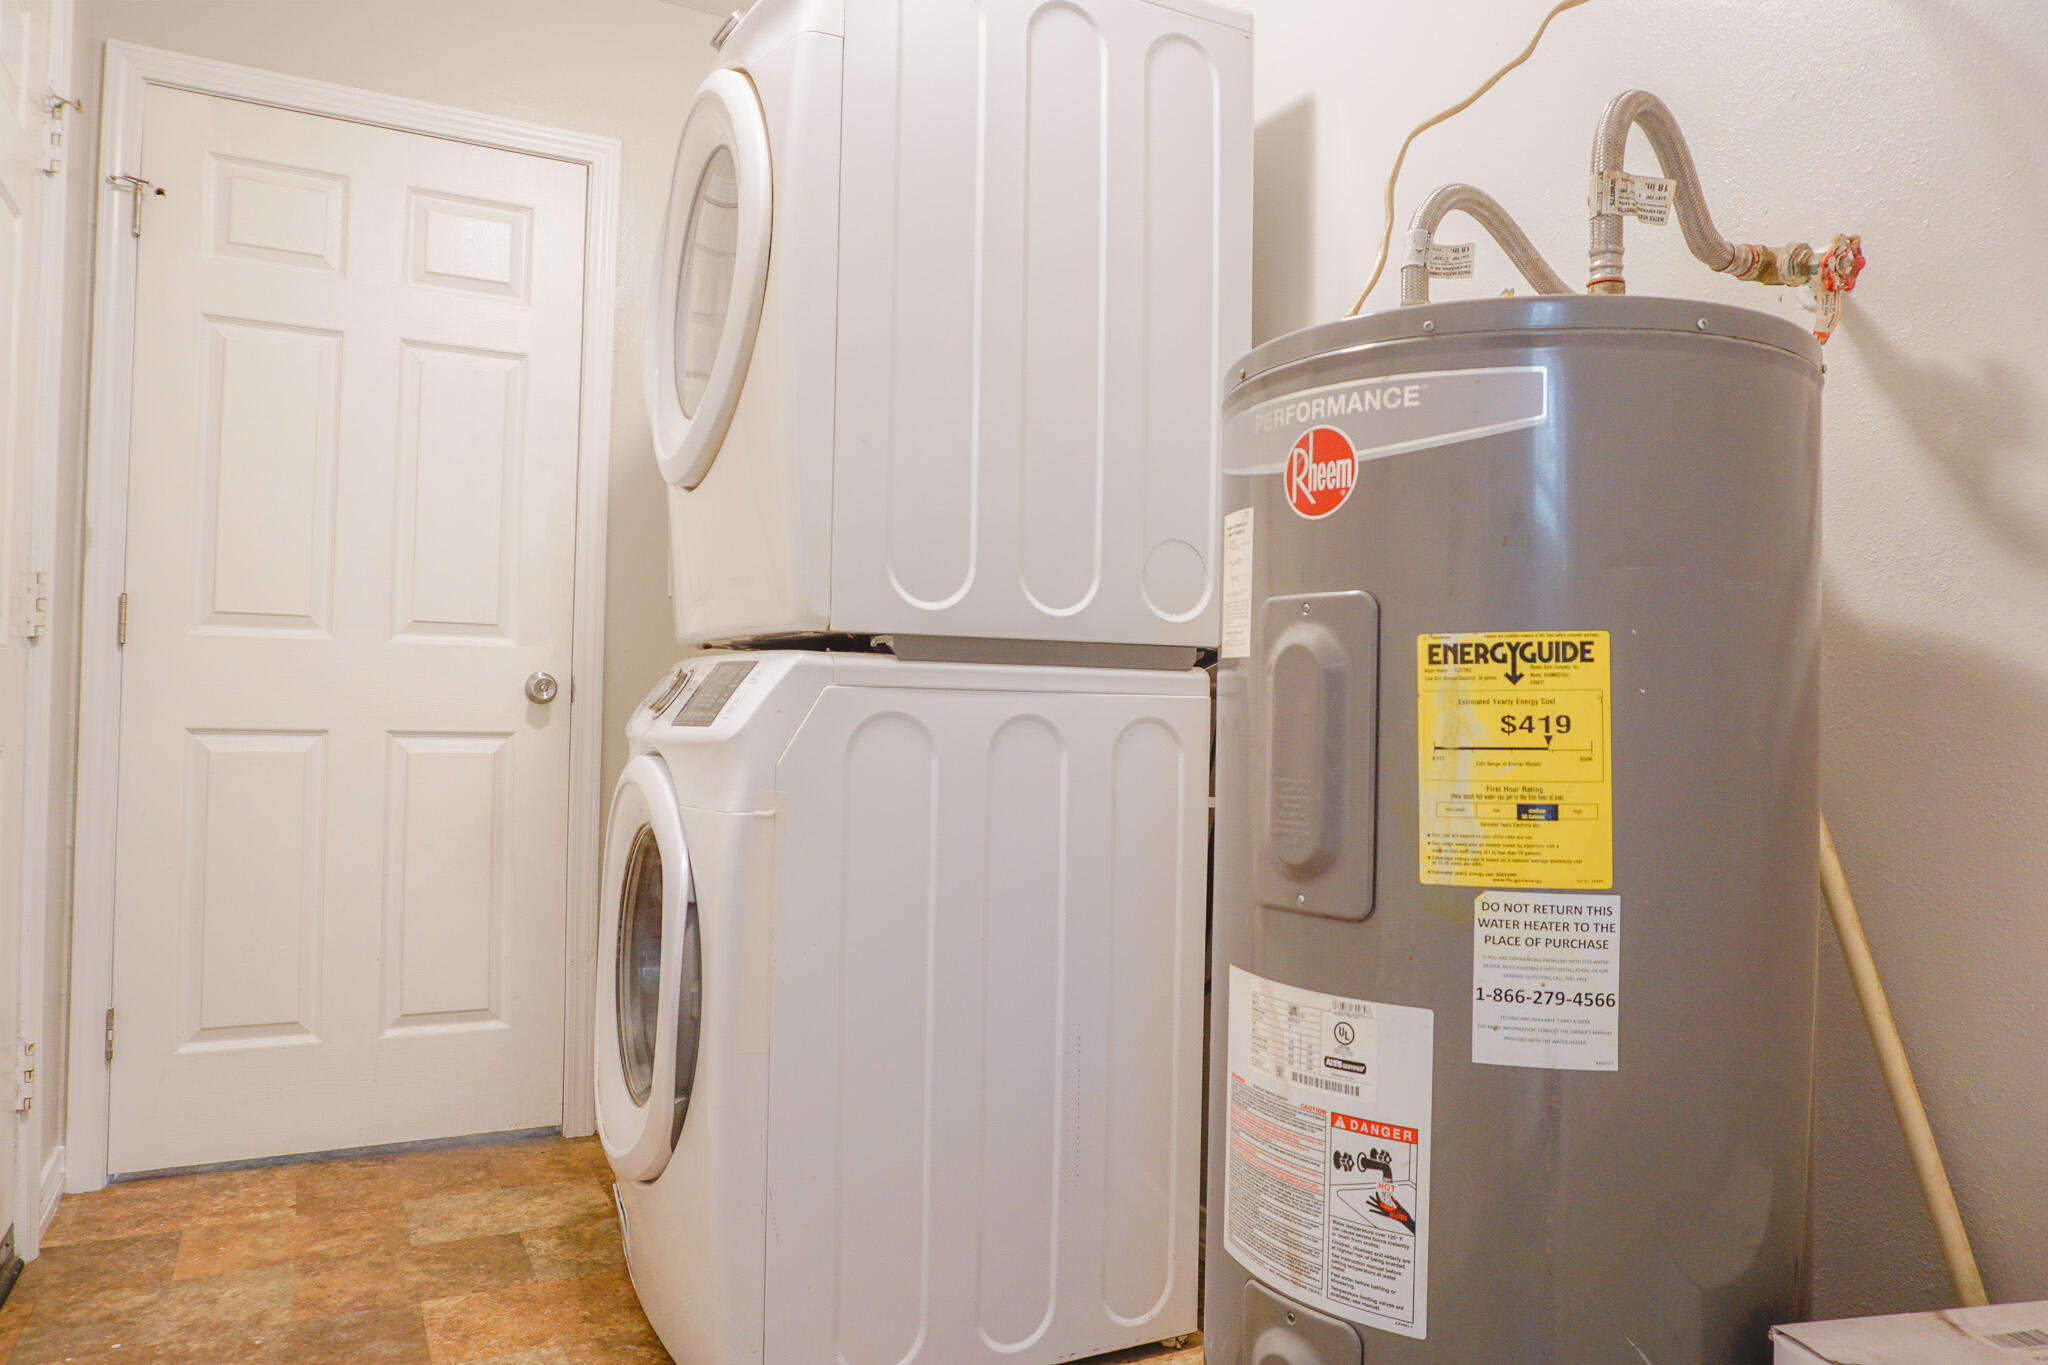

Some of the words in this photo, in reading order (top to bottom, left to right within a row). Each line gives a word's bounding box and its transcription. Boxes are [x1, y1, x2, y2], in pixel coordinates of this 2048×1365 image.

[1658, 184, 1668, 192] 18
[1255, 384, 1420, 433] PERFORMANCE
[1292, 430, 1352, 505] Rheem
[1428, 641, 1594, 668] ENERGYGUIDE
[1493, 698, 1513, 706] Yearly
[1516, 698, 1538, 706] Energy
[1501, 715, 1570, 735] $419
[1522, 786, 1543, 794] Rating
[1481, 901, 1499, 912] DO
[1504, 903, 1529, 913] NOT
[1534, 904, 1583, 915] RETURN
[1586, 906, 1613, 916] THIS
[1478, 918, 1520, 930] WATER
[1524, 920, 1570, 932] HEATER
[1573, 922, 1590, 932] TO
[1593, 923, 1616, 933] THE
[1484, 935, 1521, 947] PLACE
[1525, 937, 1541, 947] OF
[1545, 938, 1609, 950] PURCHASE
[1476, 987, 1616, 1007] 1-866-279-4566
[1300, 1103, 1326, 1114] CAUTION
[1350, 1120, 1412, 1141] DANGER
[1378, 1183, 1396, 1192] HOT
